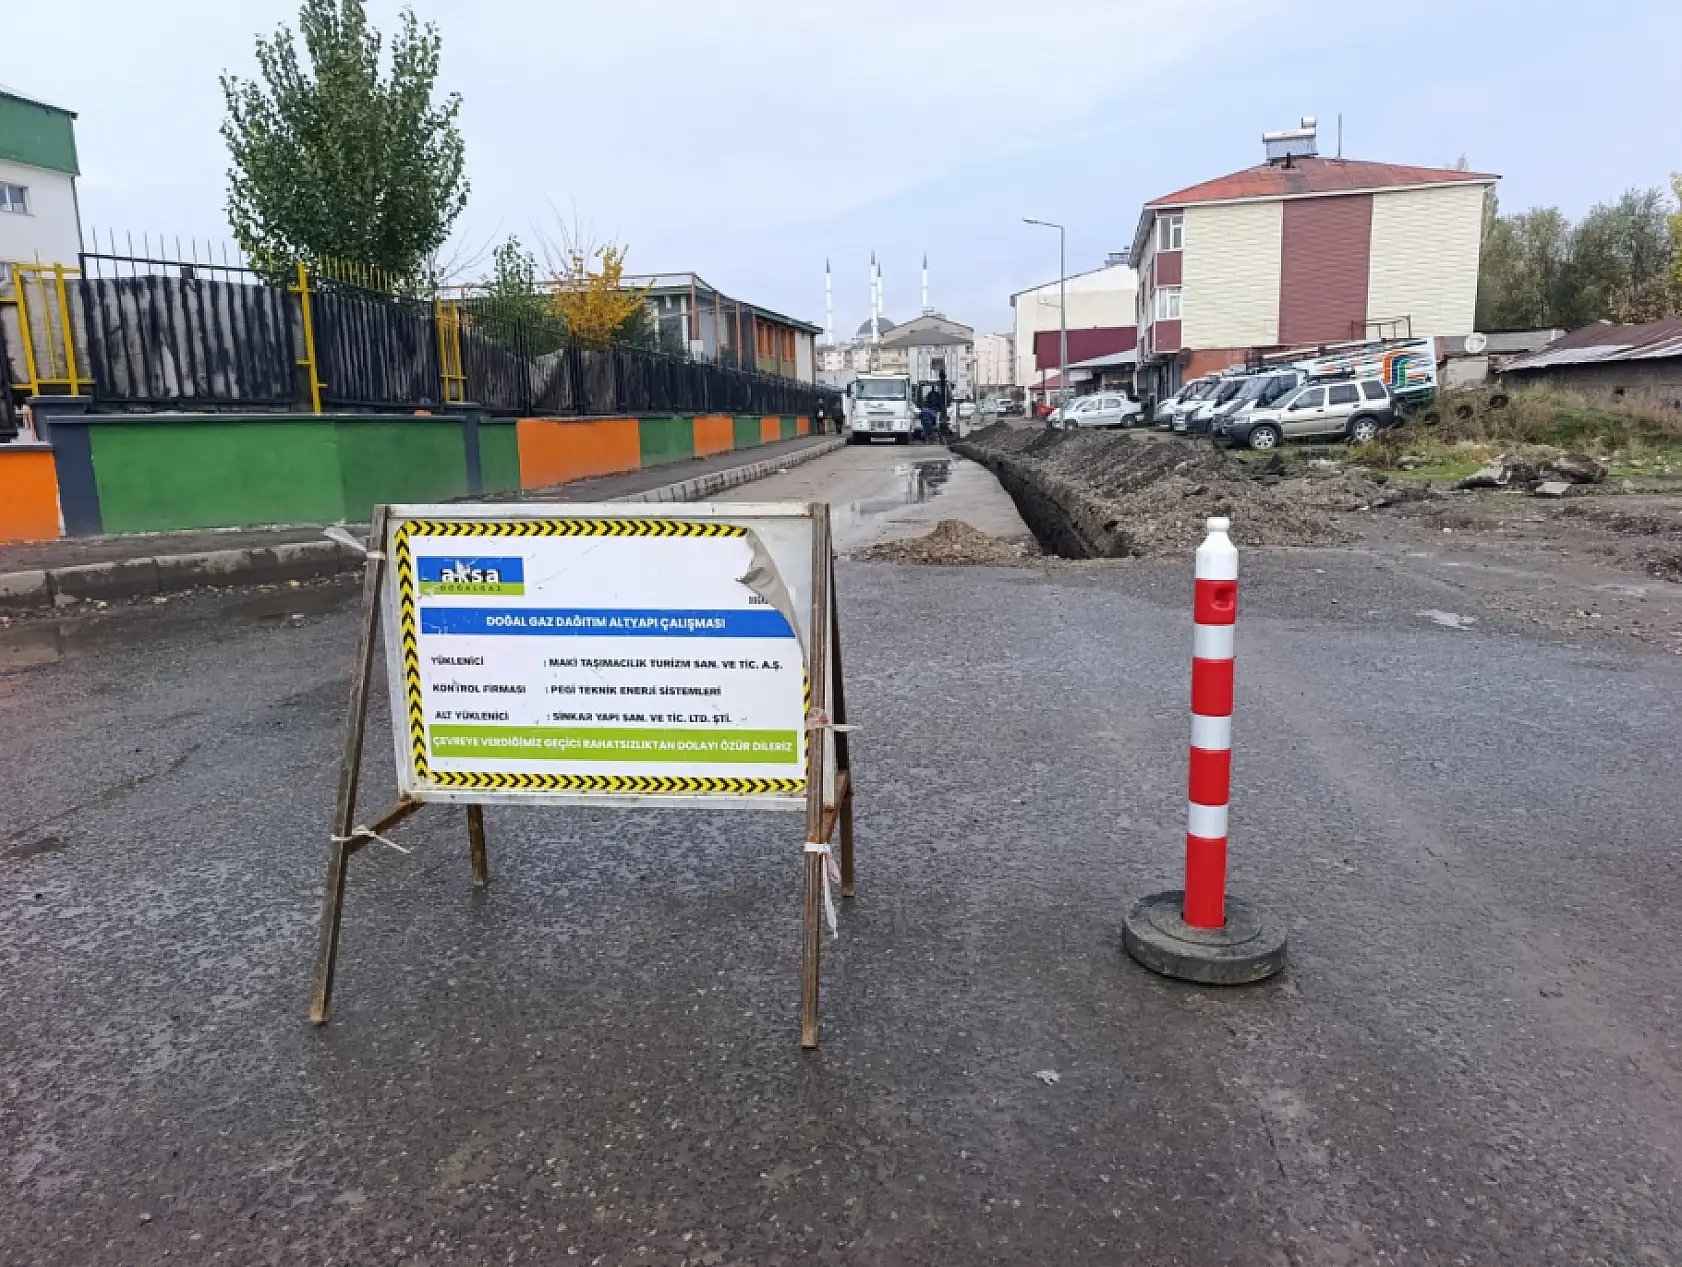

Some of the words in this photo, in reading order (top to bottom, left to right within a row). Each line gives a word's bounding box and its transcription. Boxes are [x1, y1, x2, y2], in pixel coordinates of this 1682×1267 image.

[441, 559, 500, 583] aksa
[486, 613, 528, 627] DOĞAL
[529, 616, 554, 627] GAZ
[556, 613, 606, 628] DAĞITIM
[608, 617, 659, 629] ALTYAPI
[660, 617, 726, 632] ÇALIŞMASI
[431, 655, 484, 666] YÜKLENİCİ
[580, 658, 647, 670] TAŞIMACILIK
[650, 658, 691, 669] TURİZM
[693, 660, 719, 669] SAN.
[721, 660, 736, 669] VE
[739, 659, 759, 670] TİC.
[761, 660, 783, 672] A.Ş.
[432, 684, 482, 694] KONTROL
[578, 684, 617, 696] TEKNİK
[620, 684, 656, 696] ENERJİ
[658, 685, 722, 697] SİSTEMLERİ
[434, 710, 453, 721] ALT
[455, 709, 510, 721] YÜKLENİCİ
[595, 712, 620, 722] YAPI
[623, 713, 647, 722] SAN.
[649, 713, 664, 723] VE
[666, 711, 686, 723] TİC.
[689, 713, 710, 723] LTD.
[713, 712, 732, 725] ŞTİ.
[432, 736, 479, 748] ÇEVREYE
[481, 735, 543, 748] VERDİĞİMİZ
[544, 737, 582, 750] GEÇİCİ
[583, 738, 675, 750] RAHATSIZLIKTAN
[676, 740, 718, 751] DOLAYI
[720, 738, 750, 752] ÖZÜR
[752, 740, 793, 753] DİLERİZ
